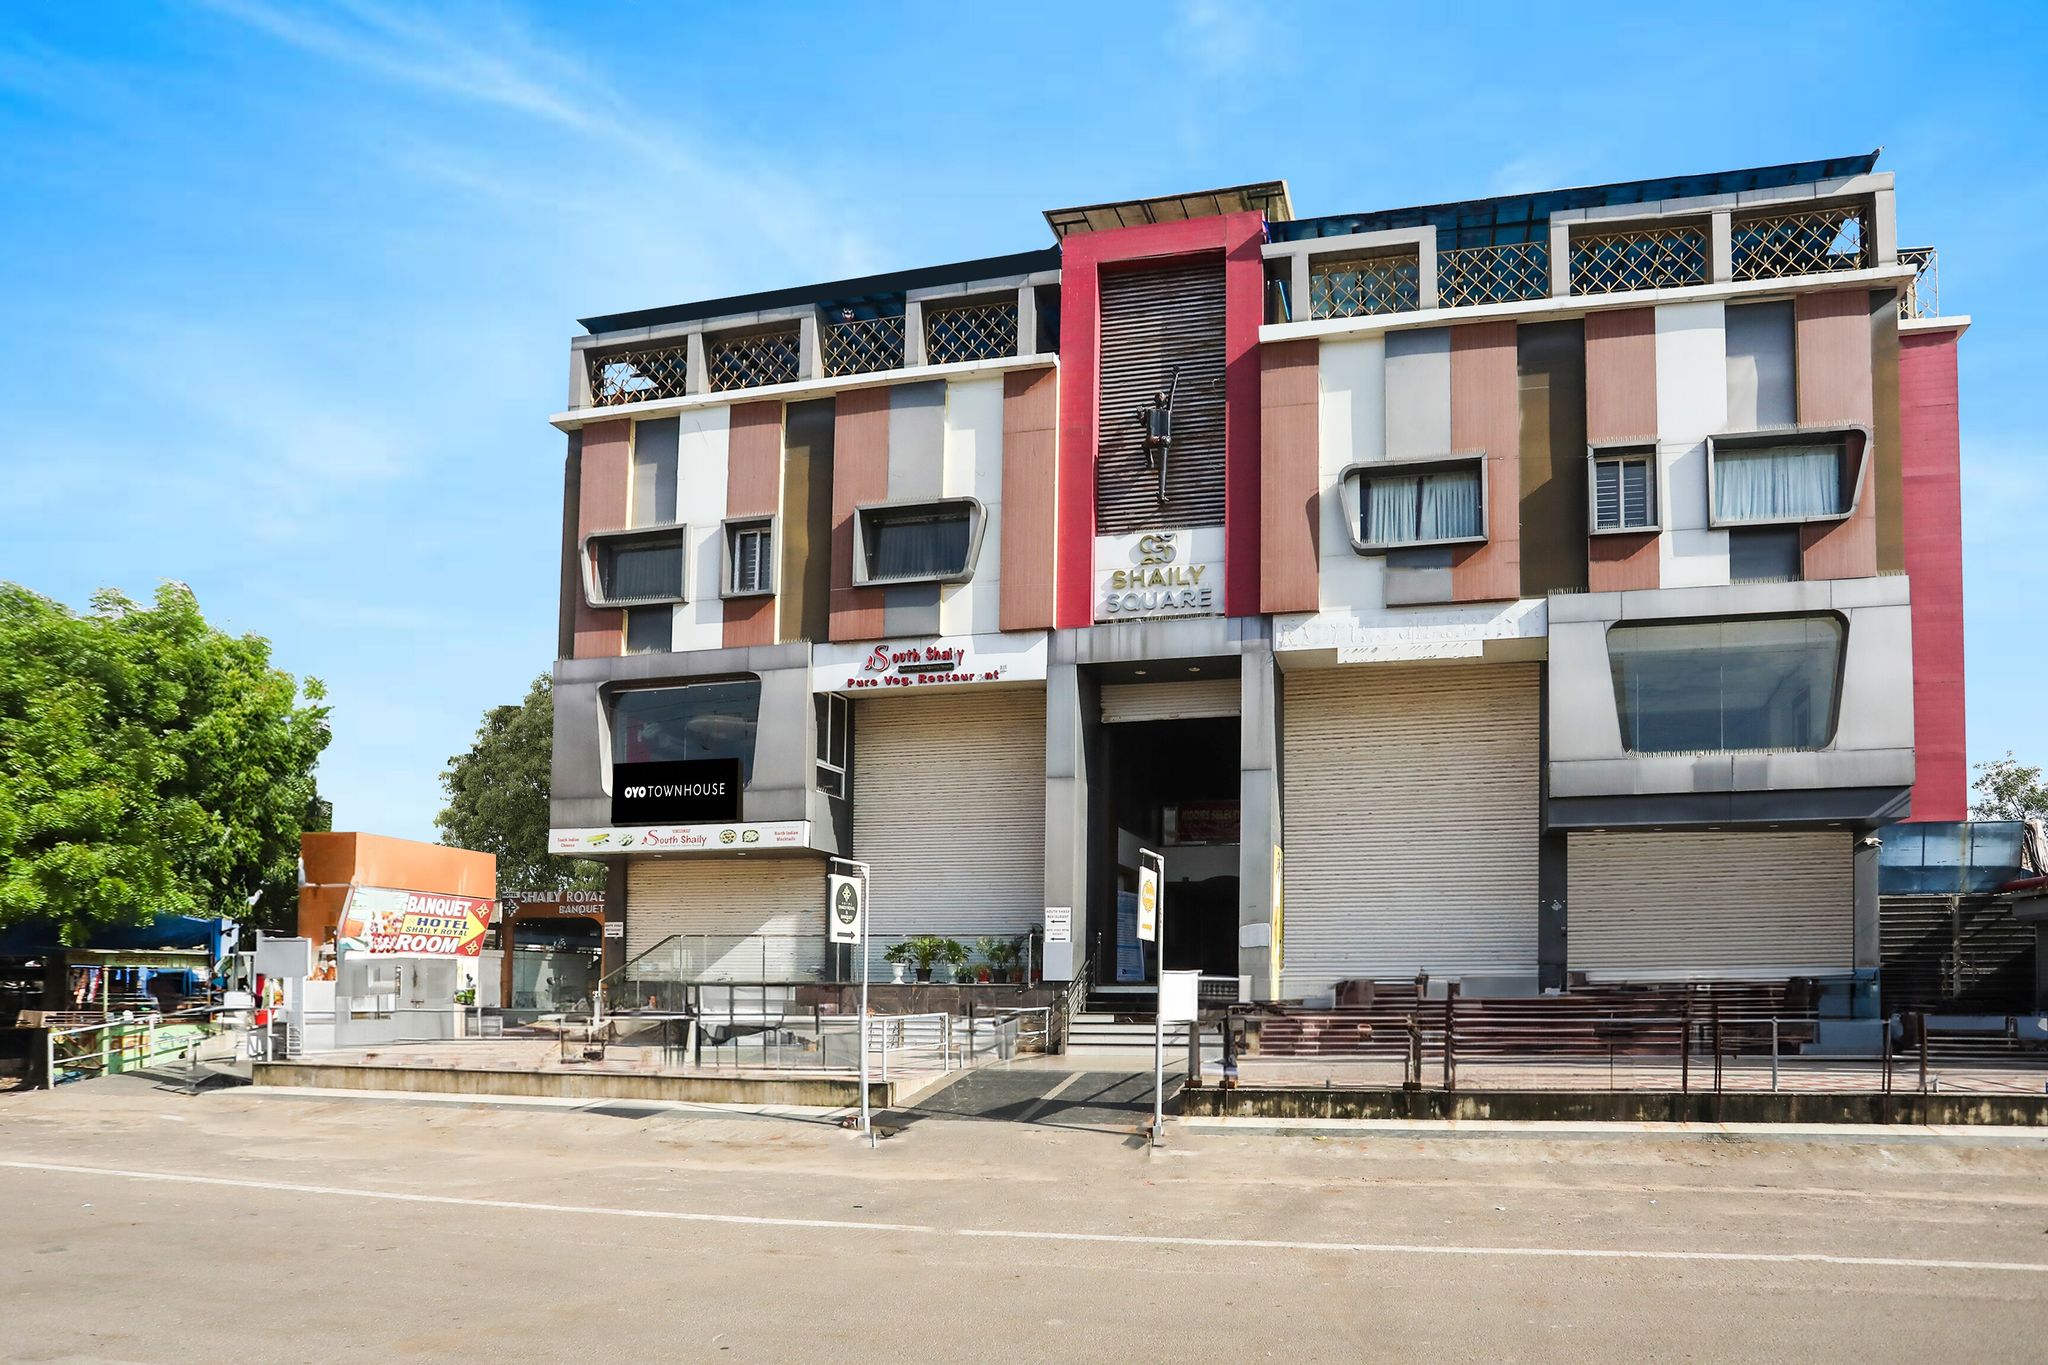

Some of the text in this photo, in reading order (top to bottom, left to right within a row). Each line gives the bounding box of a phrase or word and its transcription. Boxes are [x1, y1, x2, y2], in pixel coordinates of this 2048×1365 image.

[1111, 565, 1206, 590] SHAILY
[1106, 588, 1212, 613] SQUARE
[865, 644, 921, 672] South
[847, 678, 878, 689] Pure
[624, 782, 726, 798] OYO TOWNHOUSE
[642, 829, 707, 847] South Shaily
[521, 890, 606, 904] SHAILY ROYAL
[407, 896, 472, 917] BANQUET
[559, 904, 605, 916] BANQUET
[405, 926, 468, 936] SHAILY ROYAL
[416, 917, 470, 930] HOTEL
[396, 934, 460, 953] ROOM
